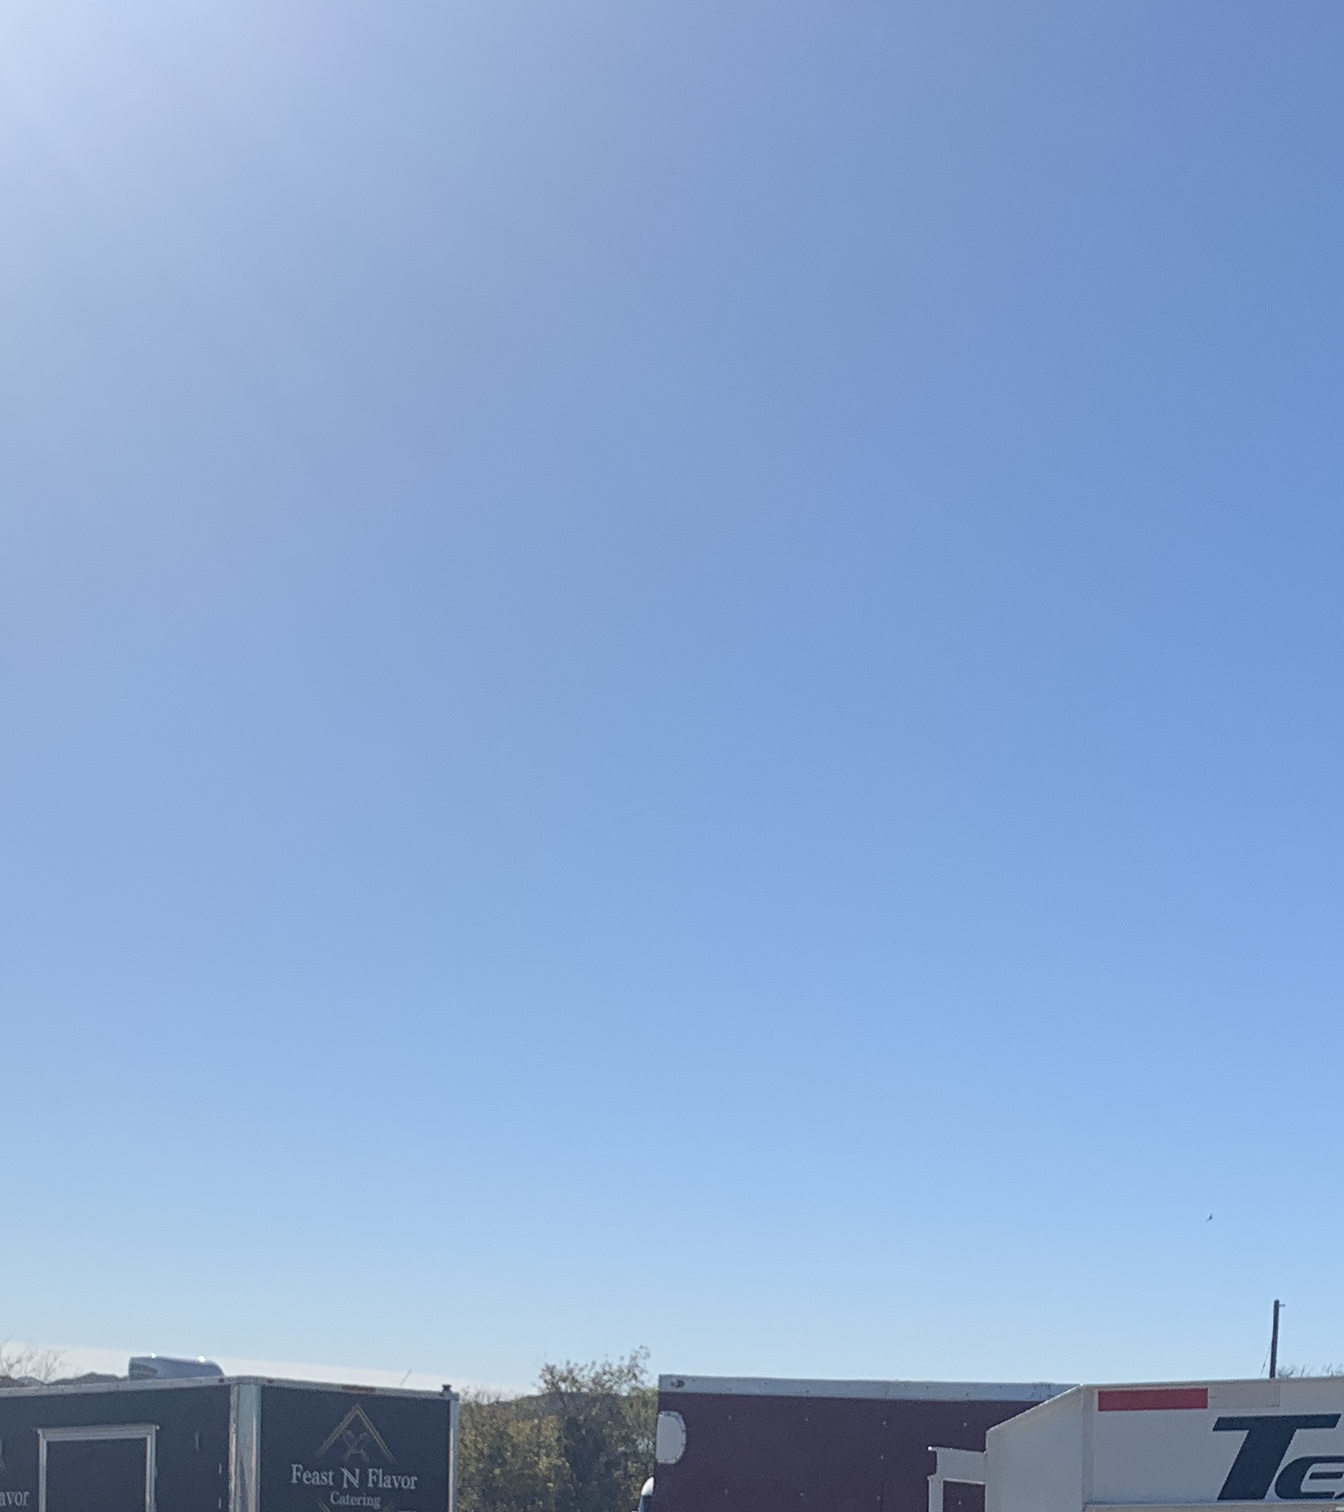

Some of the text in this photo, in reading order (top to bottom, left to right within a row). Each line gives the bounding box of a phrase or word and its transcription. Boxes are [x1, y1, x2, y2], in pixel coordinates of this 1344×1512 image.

[290, 1464, 418, 1490] Feast N Flavor
[330, 1491, 381, 1509] Catering
